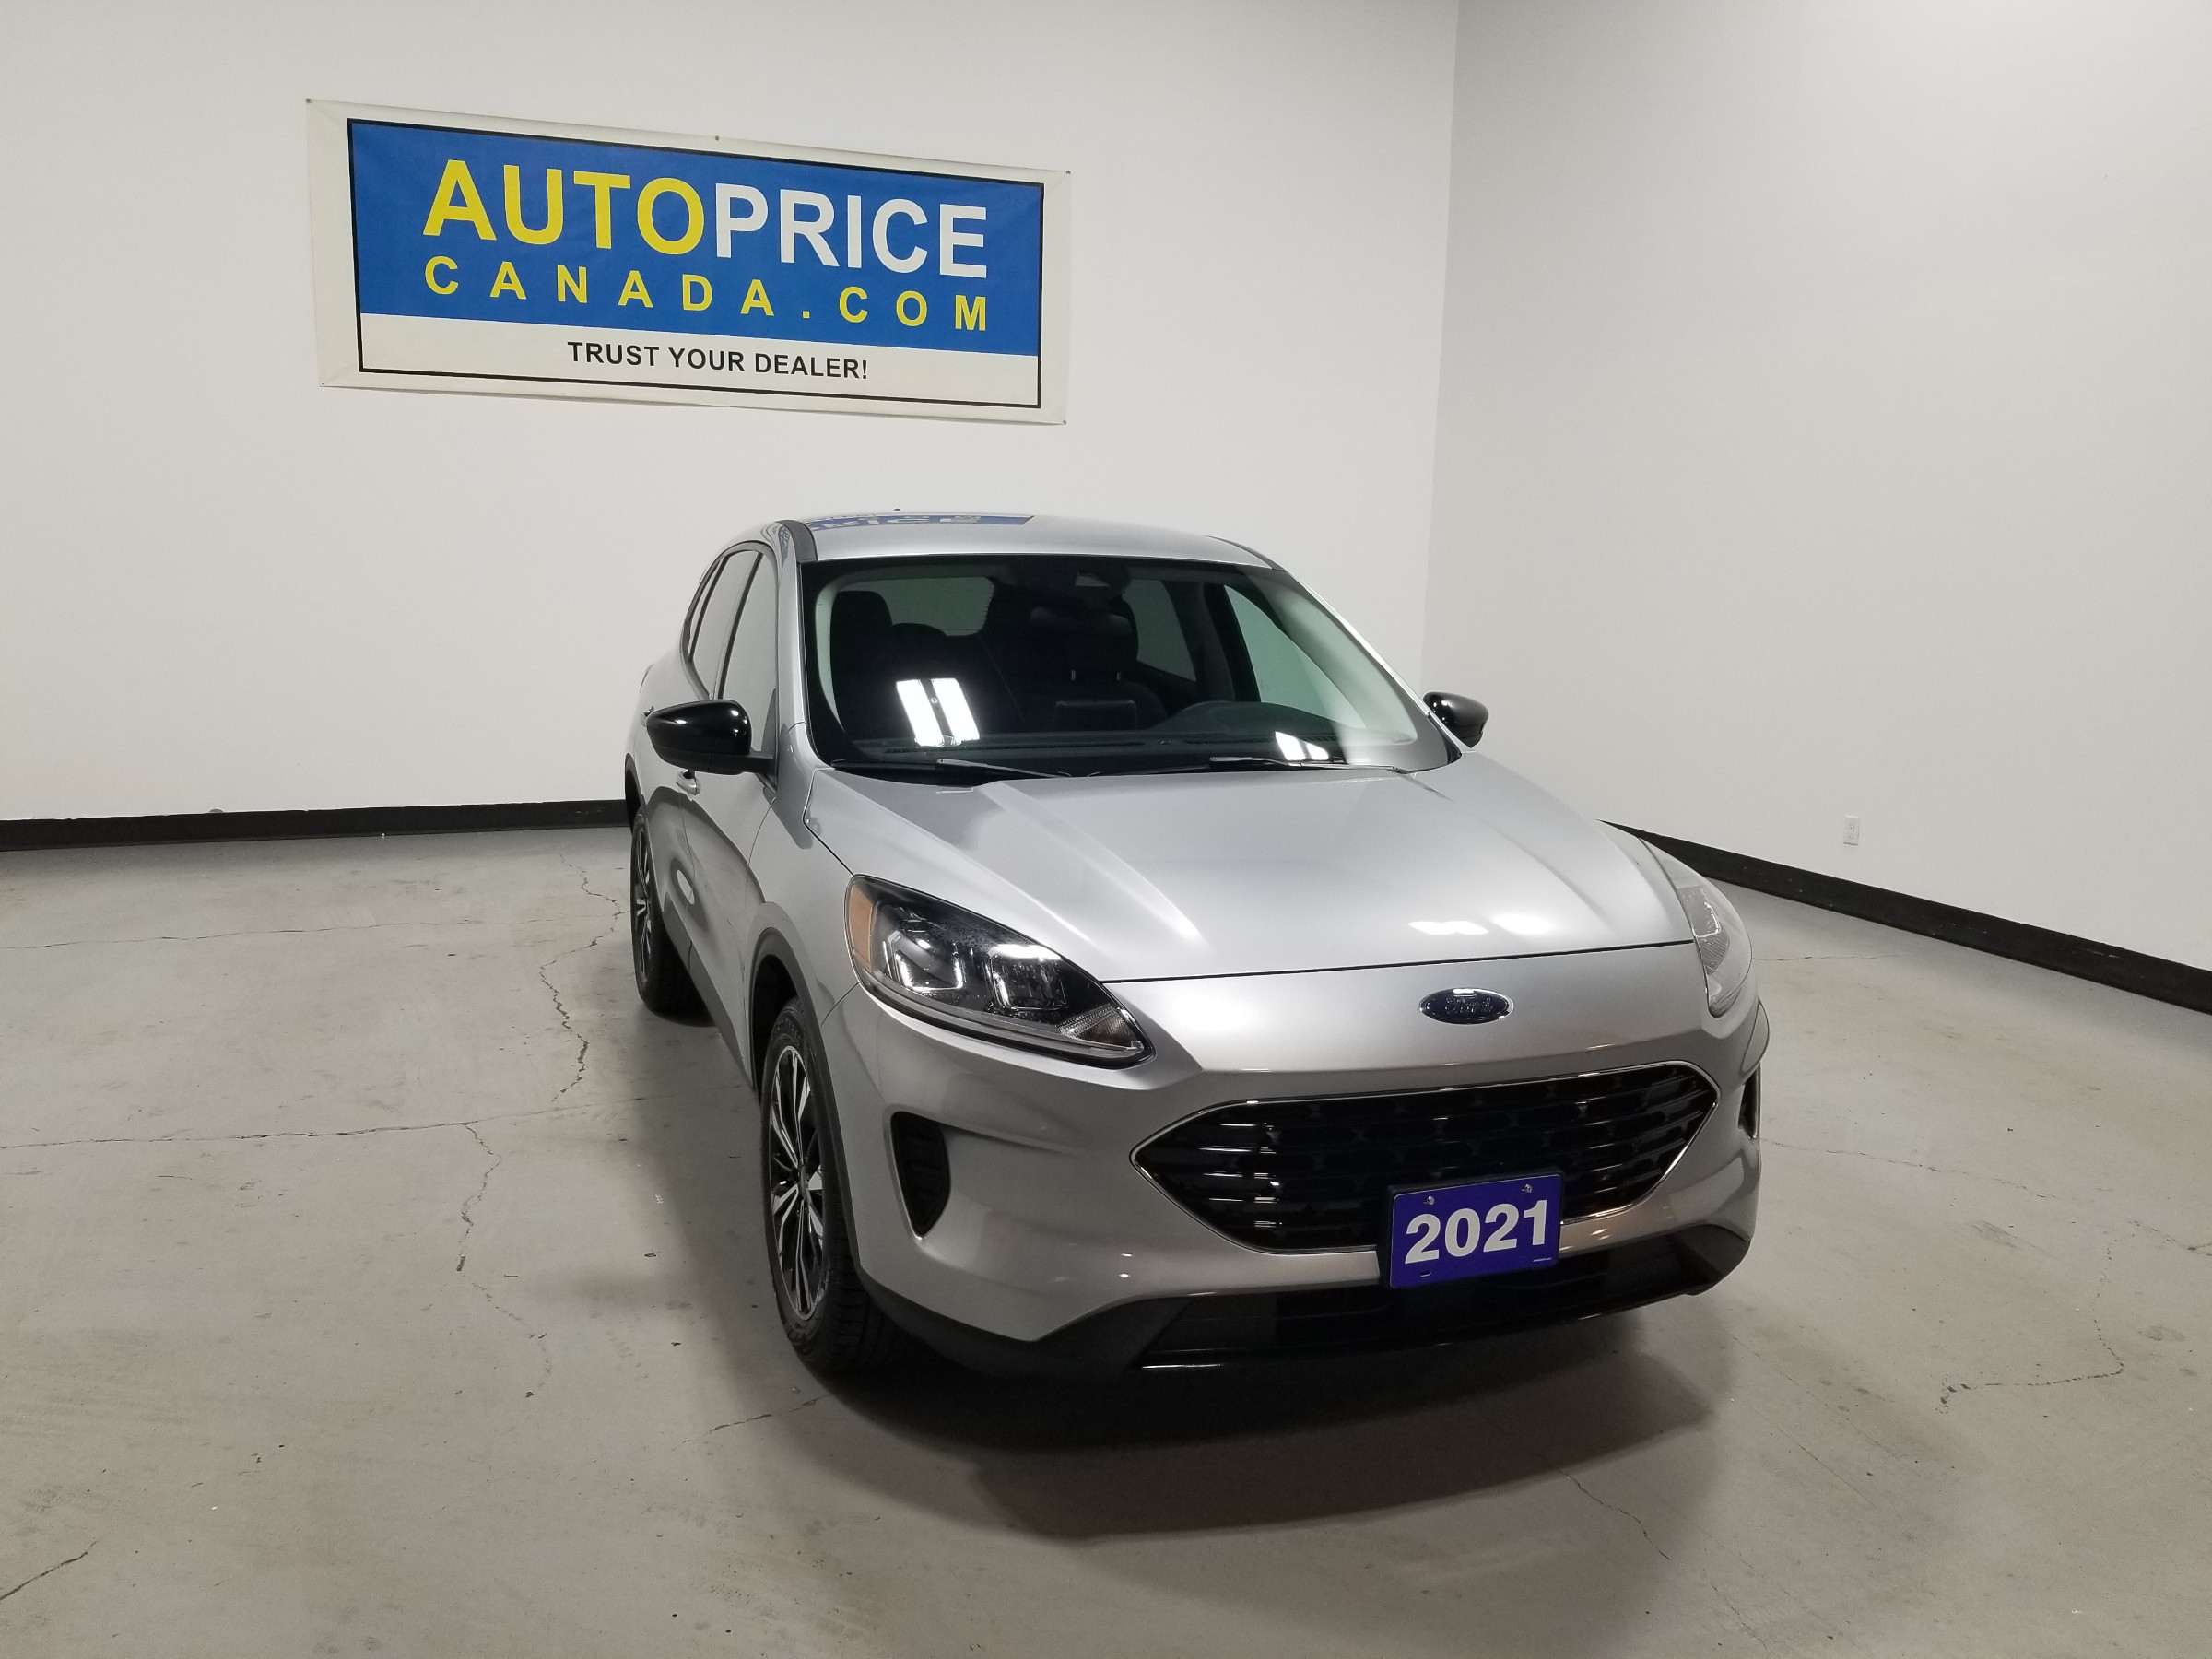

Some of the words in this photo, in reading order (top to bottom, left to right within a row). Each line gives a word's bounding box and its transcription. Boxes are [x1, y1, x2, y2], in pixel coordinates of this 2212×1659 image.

[423, 159, 987, 279] AUTOPRICE
[425, 256, 987, 333] CANADA.COM
[568, 342, 660, 366] TRUST
[669, 347, 746, 372] YOUR
[755, 352, 868, 379] DEALER!
[1405, 1200, 1547, 1264] 2021
